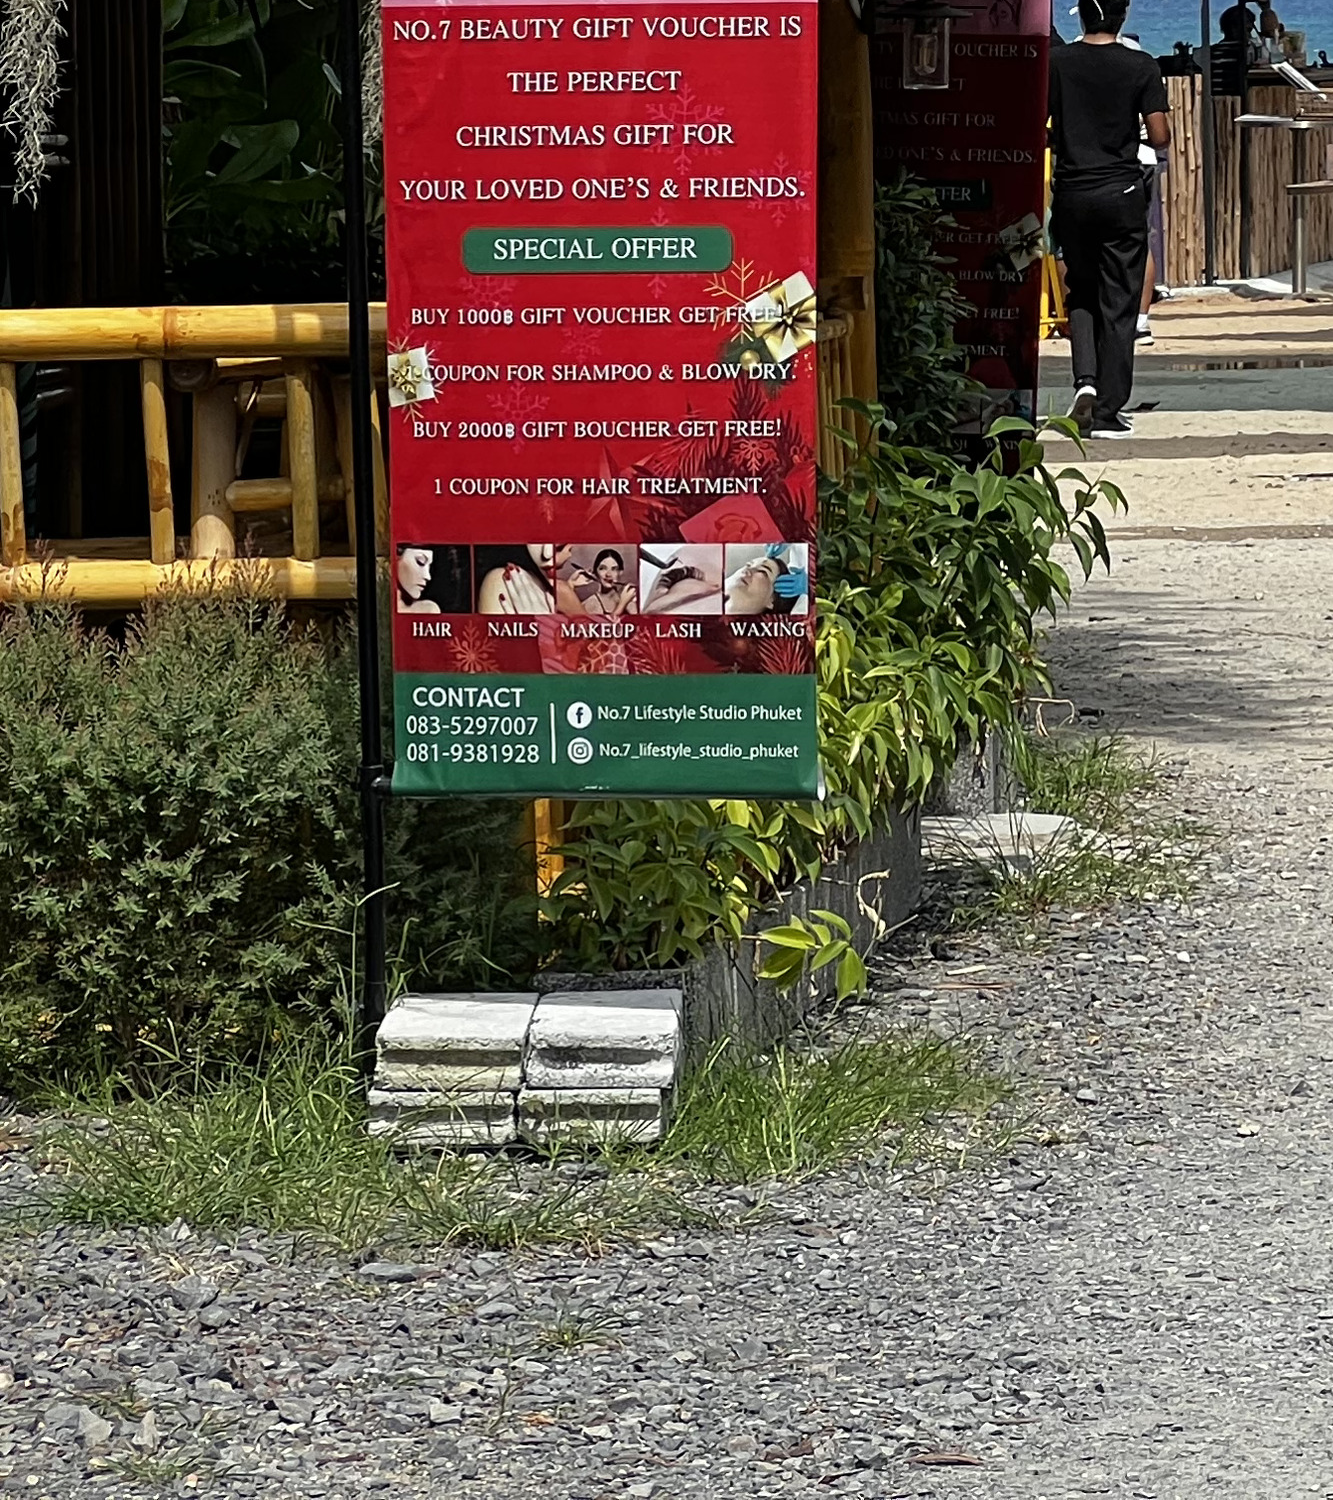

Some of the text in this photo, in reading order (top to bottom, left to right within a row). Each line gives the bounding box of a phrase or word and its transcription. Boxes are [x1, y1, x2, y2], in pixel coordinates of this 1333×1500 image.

[393, 15, 801, 41] NO.7 BEAUTY GIFT VOUCHER IS
[1024, 42, 1038, 58] IS
[507, 70, 681, 93] THE PERFECT
[924, 112, 961, 127] GIFT
[965, 112, 996, 128] FOR
[456, 123, 734, 147] CHRISTMAS GIFT FOR
[950, 148, 1038, 163] & FRIENDS.
[400, 176, 806, 201] YOUR LOVED ONE'S & FRIENDS.
[493, 237, 697, 261] SPECIAL OFFER
[411, 308, 450, 325] BUY
[520, 308, 566, 325] GIFT
[575, 307, 671, 324] VOUCHER
[678, 306, 717, 323] GET
[725, 305, 783, 323] FREE!
[422, 365, 499, 382] COUPON
[506, 365, 545, 382] FOR
[552, 364, 652, 381] SHAMPOO
[659, 364, 674, 380] &
[682, 363, 742, 380] BLOW
[748, 362, 797, 380] DRY.
[413, 421, 452, 438] BUY
[522, 421, 567, 438] GIFT
[574, 419, 672, 437] BOUCHER
[678, 419, 717, 437] GET
[725, 419, 782, 437] FREE!
[434, 477, 767, 495] 1 COUPON FOR HAIR TREATMENT.
[412, 622, 805, 639] HAIR NAILS MAKEUP LASH WAXING
[412, 687, 525, 708] CONTACT
[597, 705, 802, 723] No.7 Lifestyle Studio Phuket
[406, 716, 538, 735] 083-5297007
[406, 744, 539, 764] 081-9381928
[599, 743, 799, 760] No.7_lifestyle_studio_phuket
